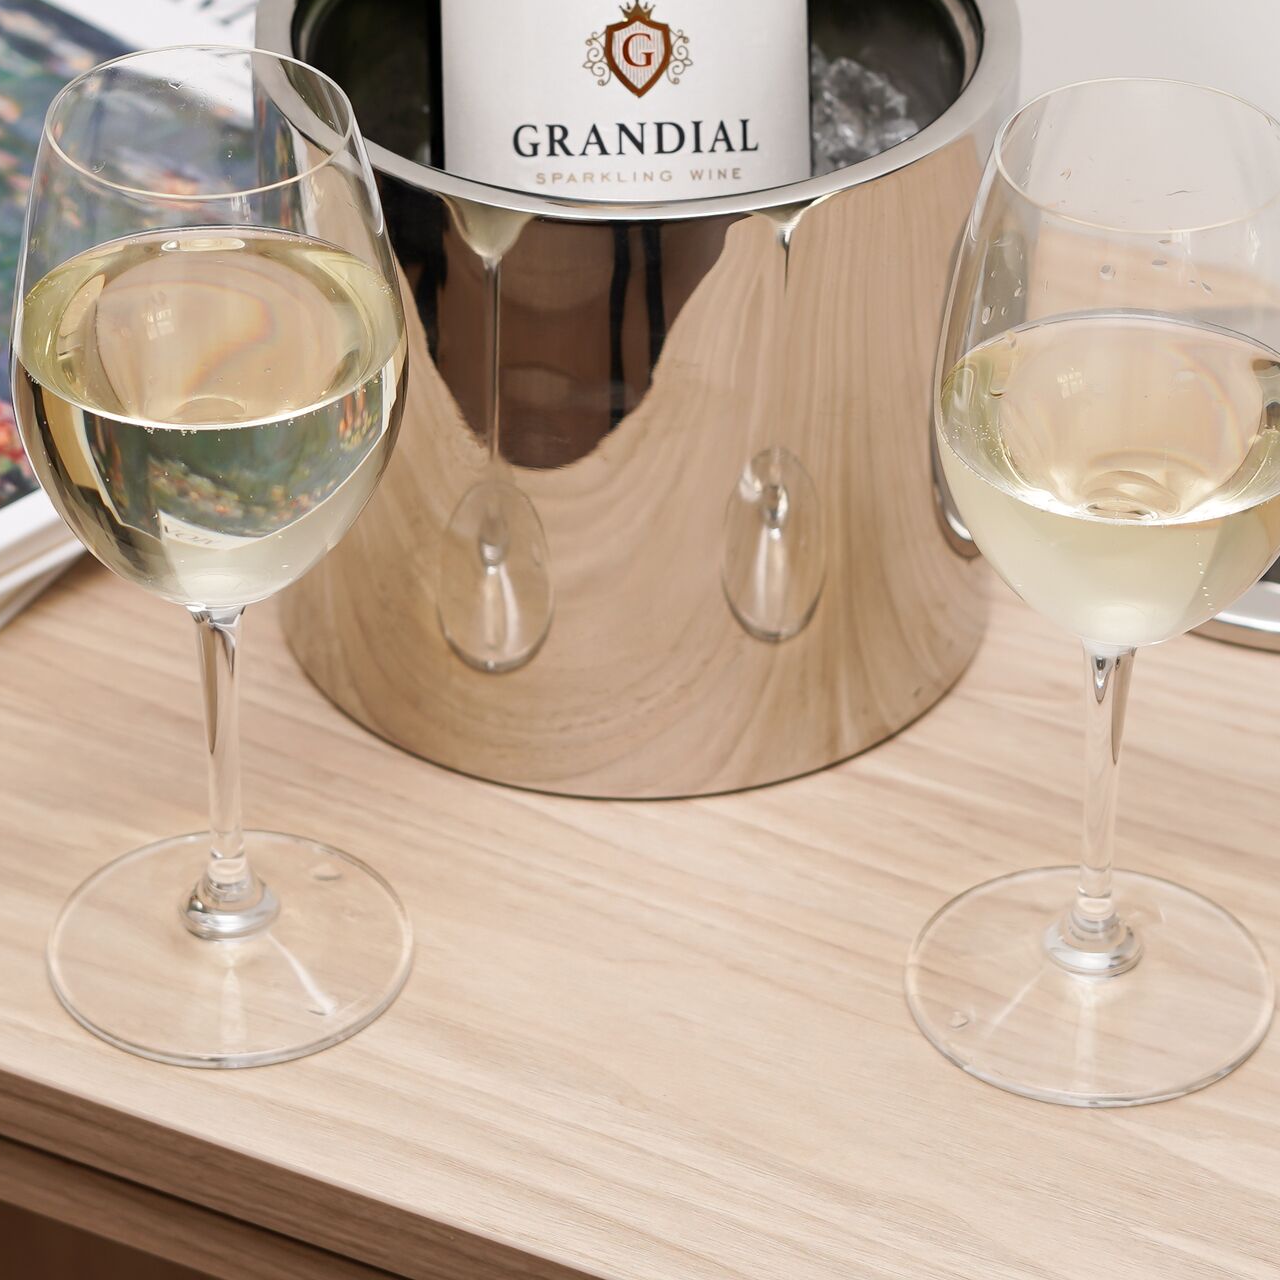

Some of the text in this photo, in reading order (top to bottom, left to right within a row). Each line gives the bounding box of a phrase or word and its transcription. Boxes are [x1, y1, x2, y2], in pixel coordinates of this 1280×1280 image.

[622, 32, 655, 68] G
[513, 119, 759, 158] GRANDIAL
[535, 166, 743, 186] SPARKLING WINE
